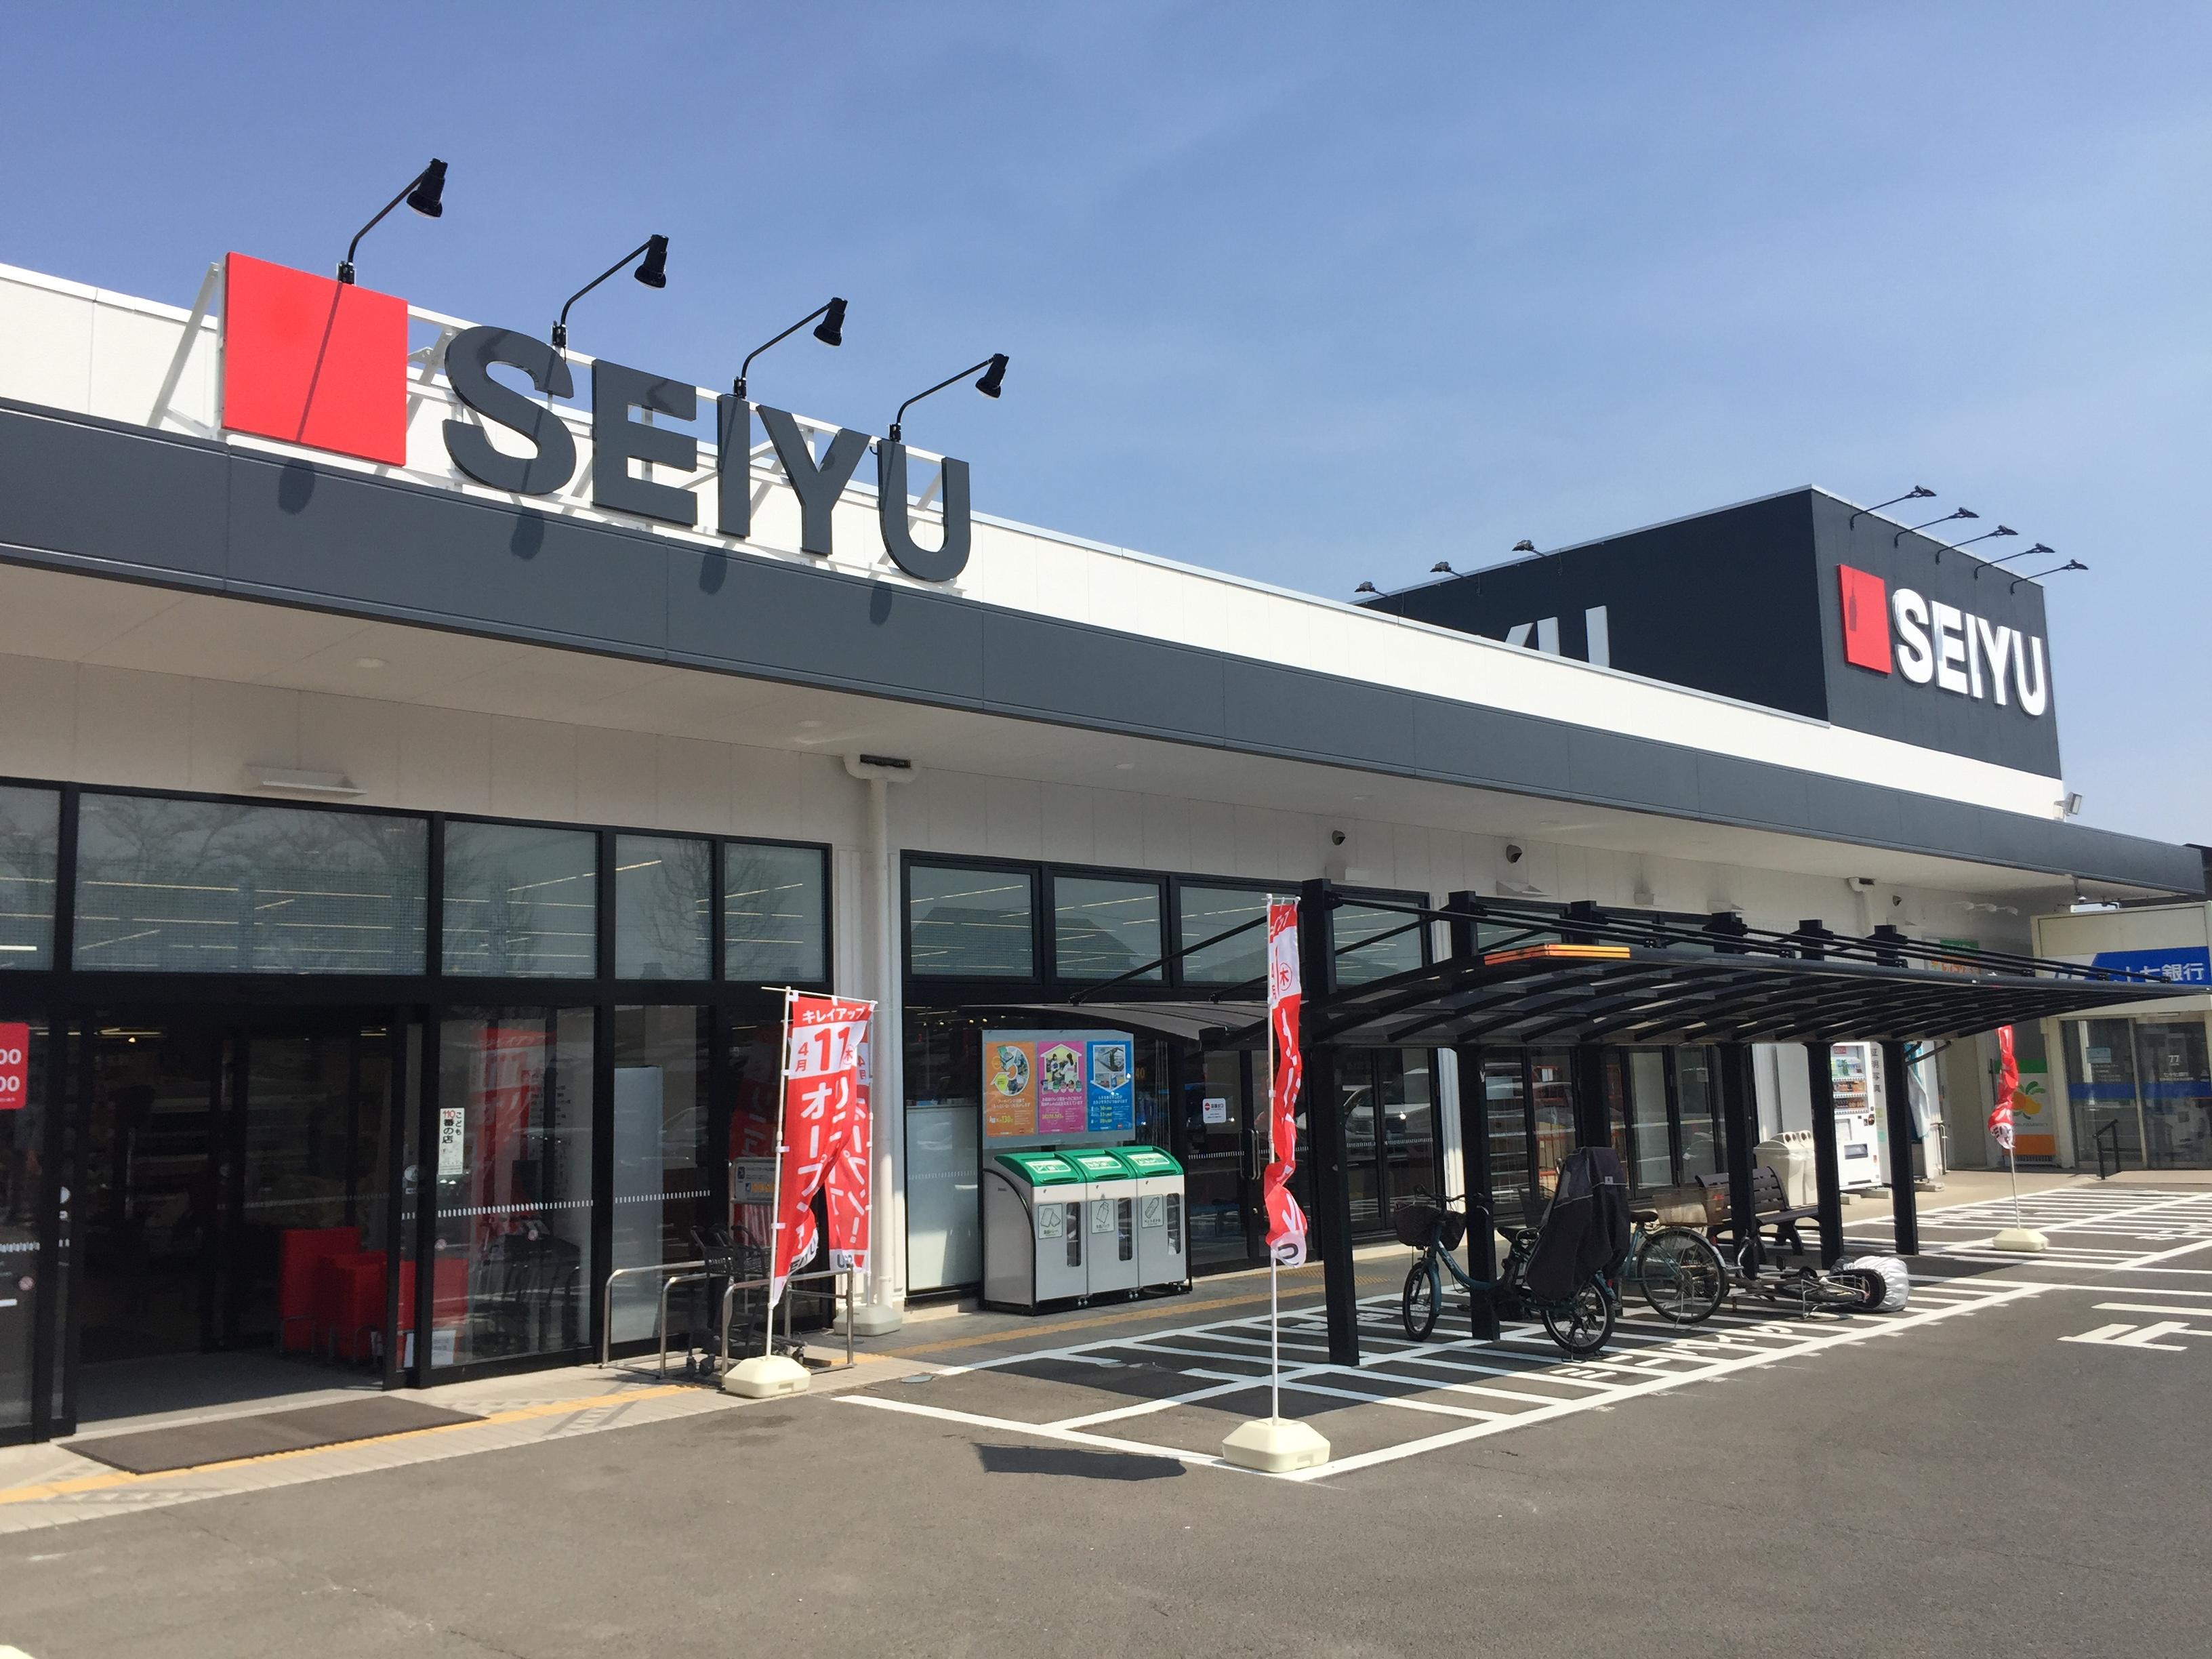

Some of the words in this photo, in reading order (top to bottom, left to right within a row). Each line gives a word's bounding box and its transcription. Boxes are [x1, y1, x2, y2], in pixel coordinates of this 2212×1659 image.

[443, 325, 972, 582] SEIYU
[1891, 588, 2047, 716] SEIYU
[802, 1006, 865, 1024] キレイアップ
[796, 1042, 810, 1072] 4月
[442, 1109, 455, 1144] 110番の店
